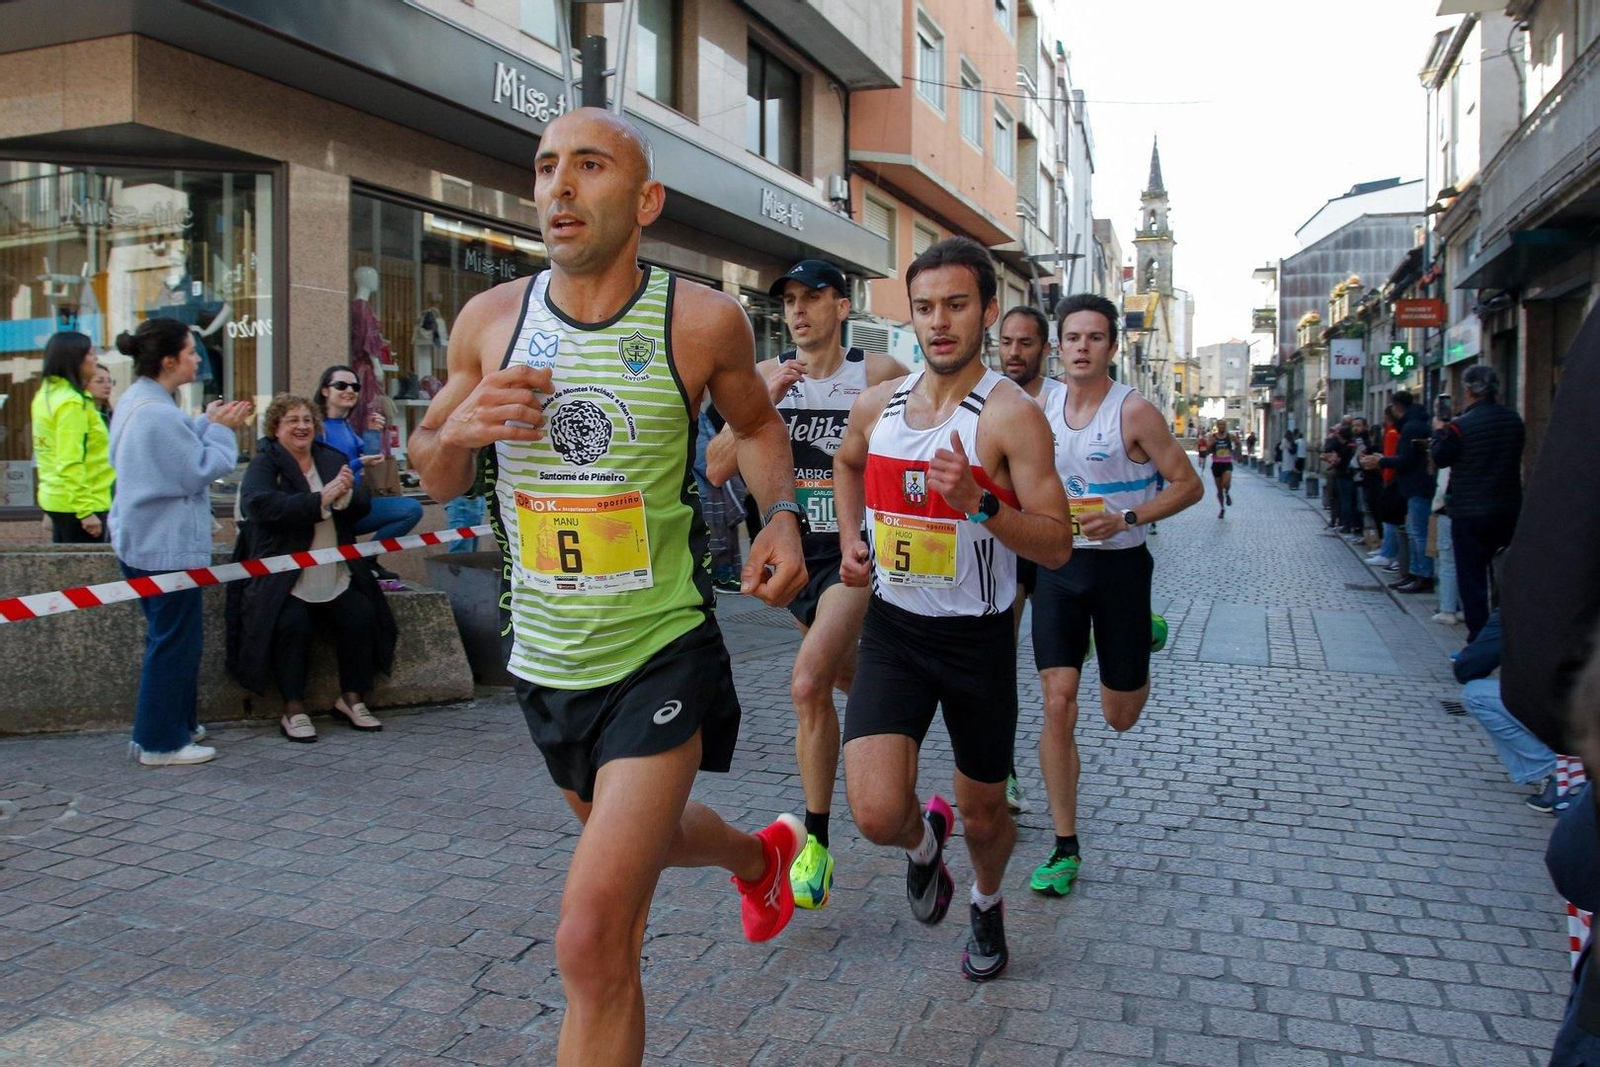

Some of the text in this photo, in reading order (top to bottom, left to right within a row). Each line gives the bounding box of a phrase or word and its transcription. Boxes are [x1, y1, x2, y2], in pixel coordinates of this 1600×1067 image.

[761, 188, 804, 231] Miss-tic
[465, 248, 517, 279] Miss-tic
[1334, 354, 1360, 365] Tere
[554, 391, 563, 399] de
[563, 386, 588, 395] Montes
[618, 401, 630, 416] Man
[539, 471, 626, 482] Santomé de Piñeiro
[553, 517, 579, 526] MANU
[895, 529, 913, 539] HUGO
[557, 530, 583, 573] 6
[895, 540, 911, 571] 5
